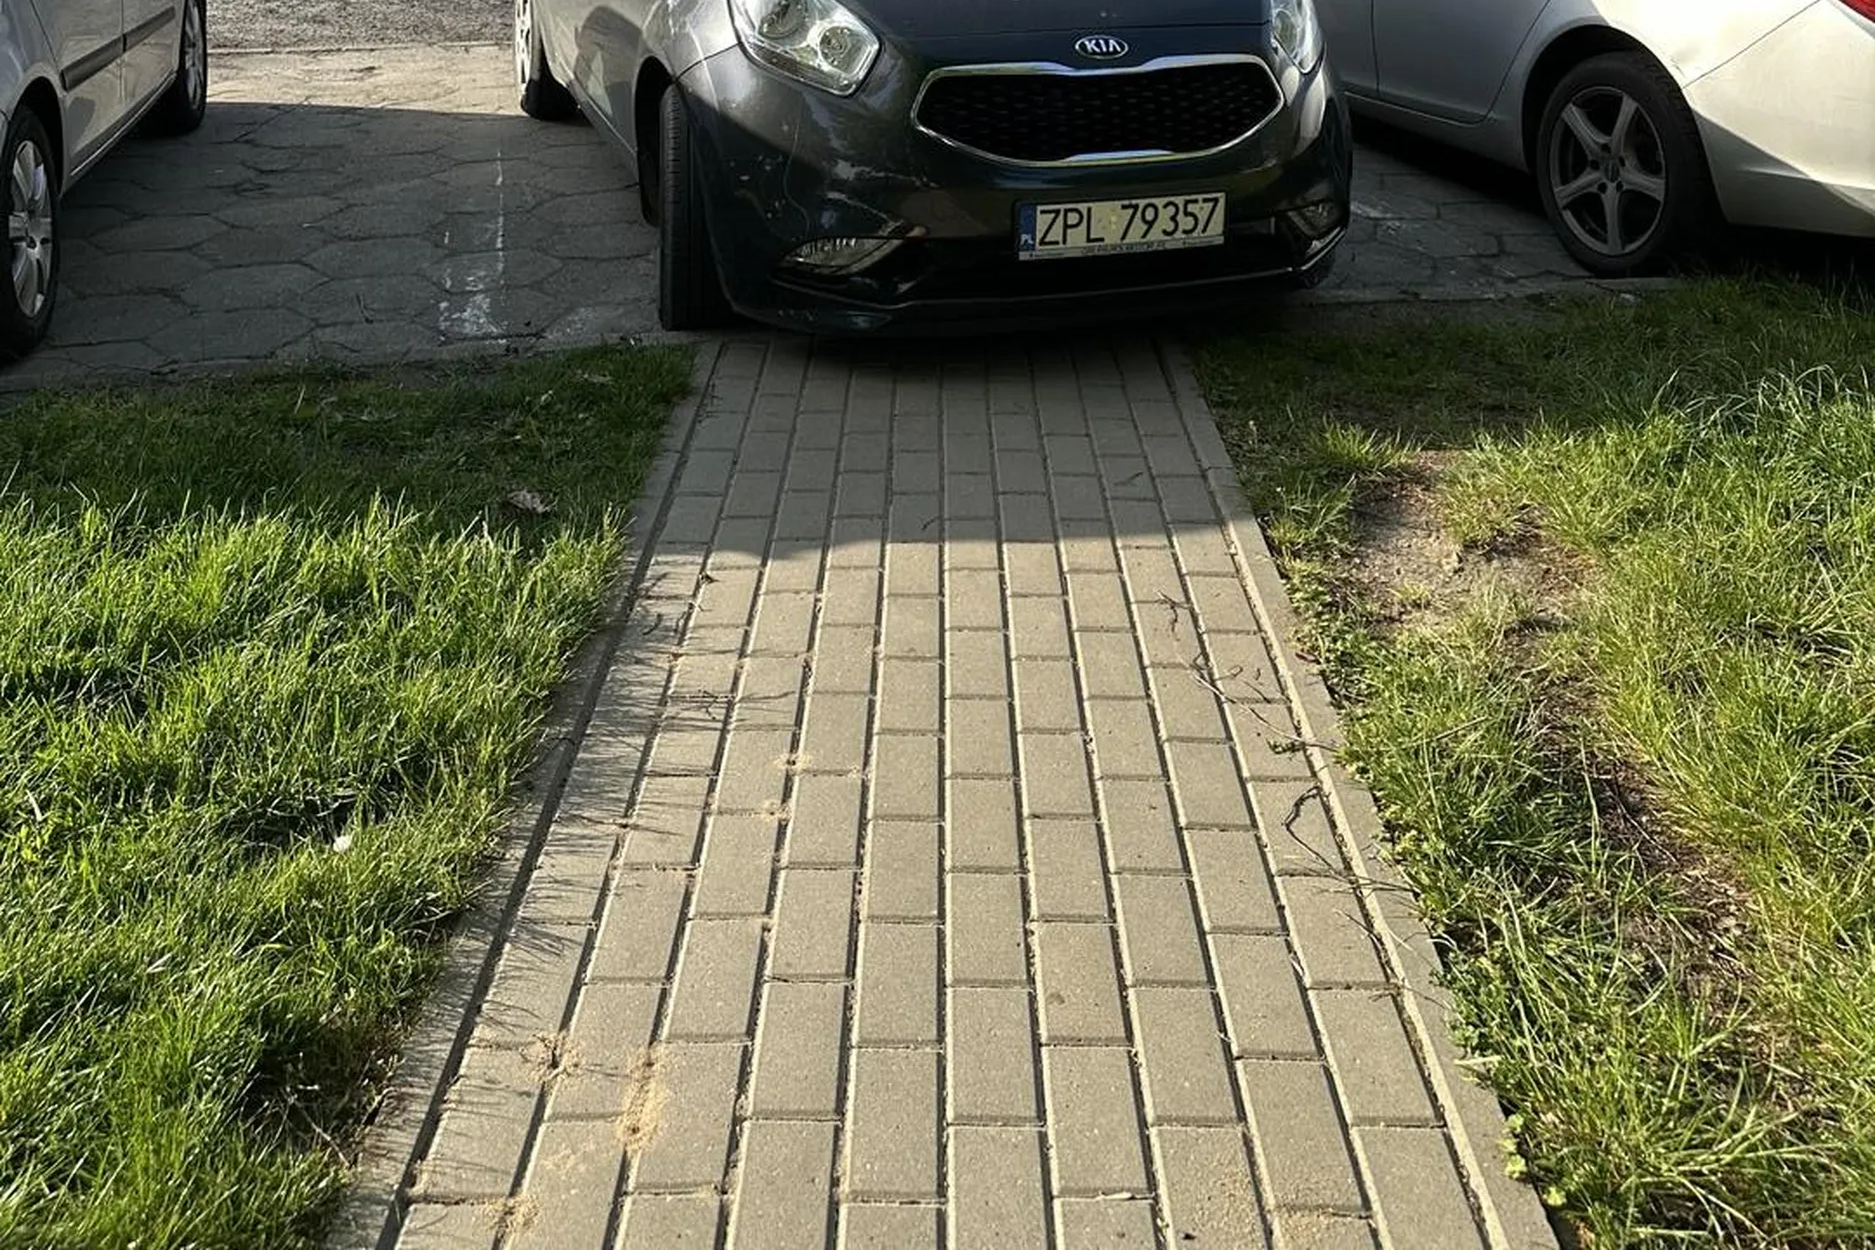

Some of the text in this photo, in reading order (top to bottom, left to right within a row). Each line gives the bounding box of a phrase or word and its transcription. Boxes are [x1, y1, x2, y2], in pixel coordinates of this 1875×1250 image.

[1084, 39, 1122, 54] KIA
[1039, 197, 1220, 247] ZPL 79357
